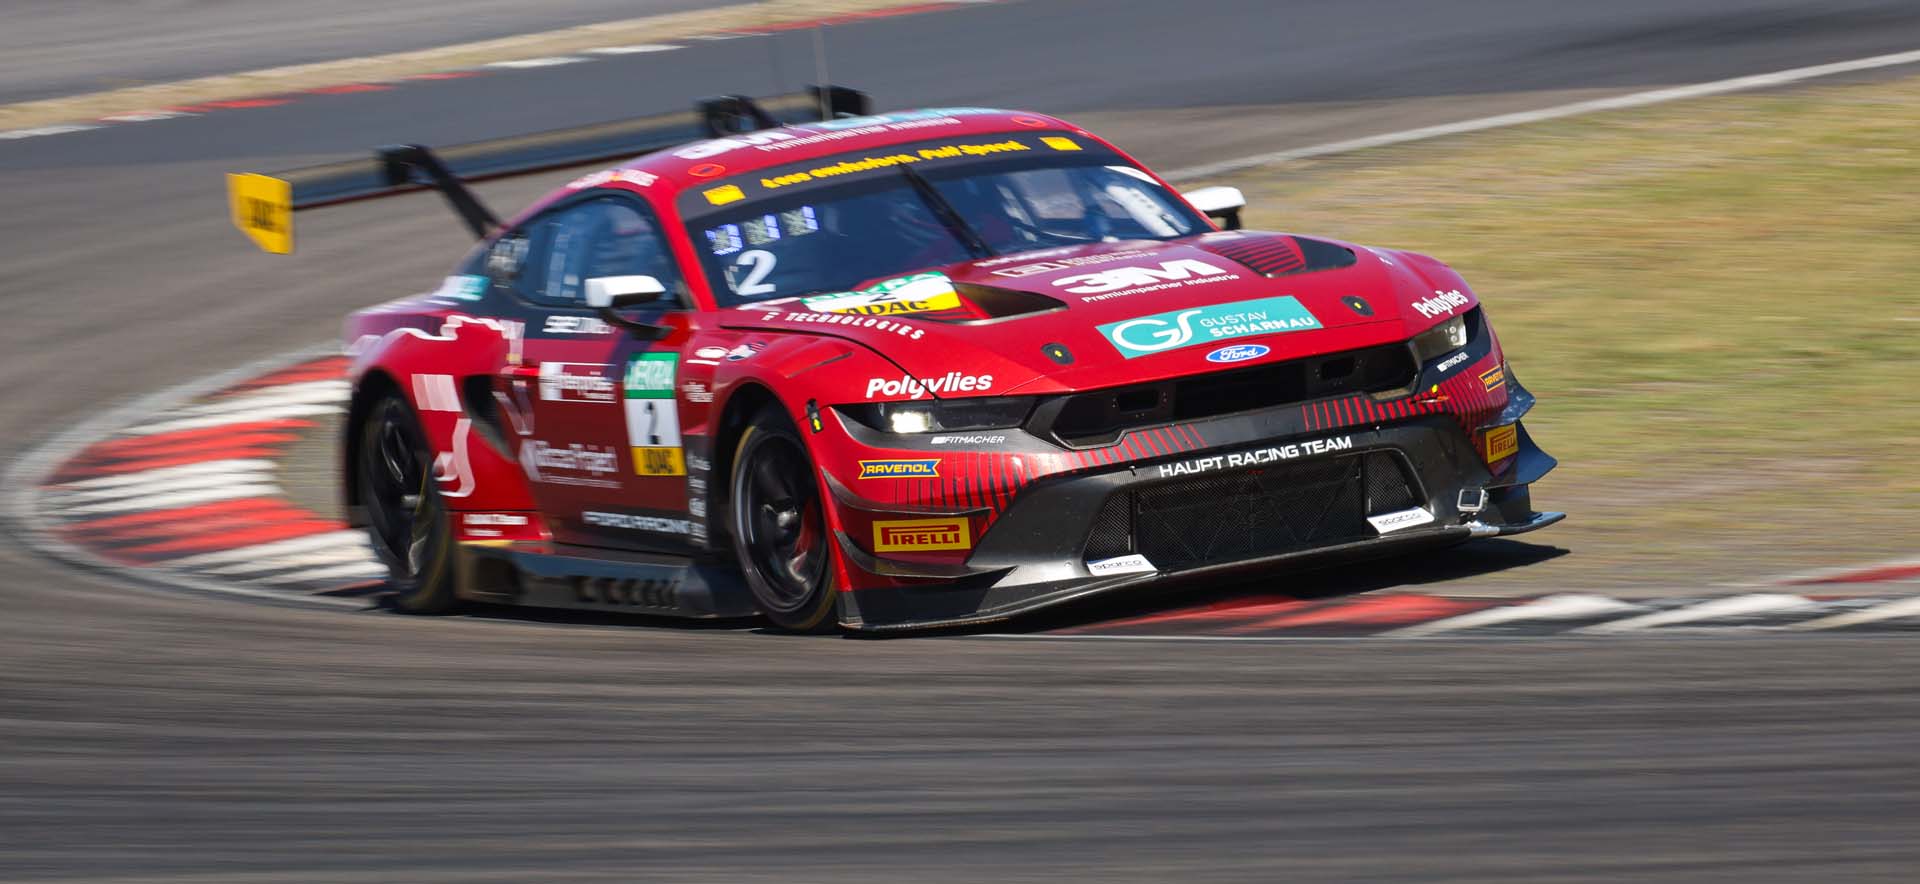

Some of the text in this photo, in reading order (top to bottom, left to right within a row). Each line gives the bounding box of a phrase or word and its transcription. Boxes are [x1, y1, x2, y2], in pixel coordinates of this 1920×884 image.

[735, 249, 777, 297] 2
[1051, 258, 1227, 294] 3M
[1081, 274, 1240, 303] Premiumpartner Industrie
[846, 300, 929, 316] ADAC
[1199, 311, 1268, 328] GUSTAV
[785, 311, 925, 339] TECHNOLOGIES
[1209, 316, 1315, 337] SCHARNAU
[1219, 346, 1259, 361] Ford
[866, 372, 992, 399] Polyvlies
[645, 401, 660, 445] 2
[944, 435, 1005, 445] FITMACHER
[1490, 430, 1515, 456] PIRELLI
[865, 463, 932, 474] RAVENOL
[1159, 436, 1352, 478] HAUPT RACING TEAM
[881, 525, 960, 546] PIRELLI
[1093, 559, 1143, 572] sparco
